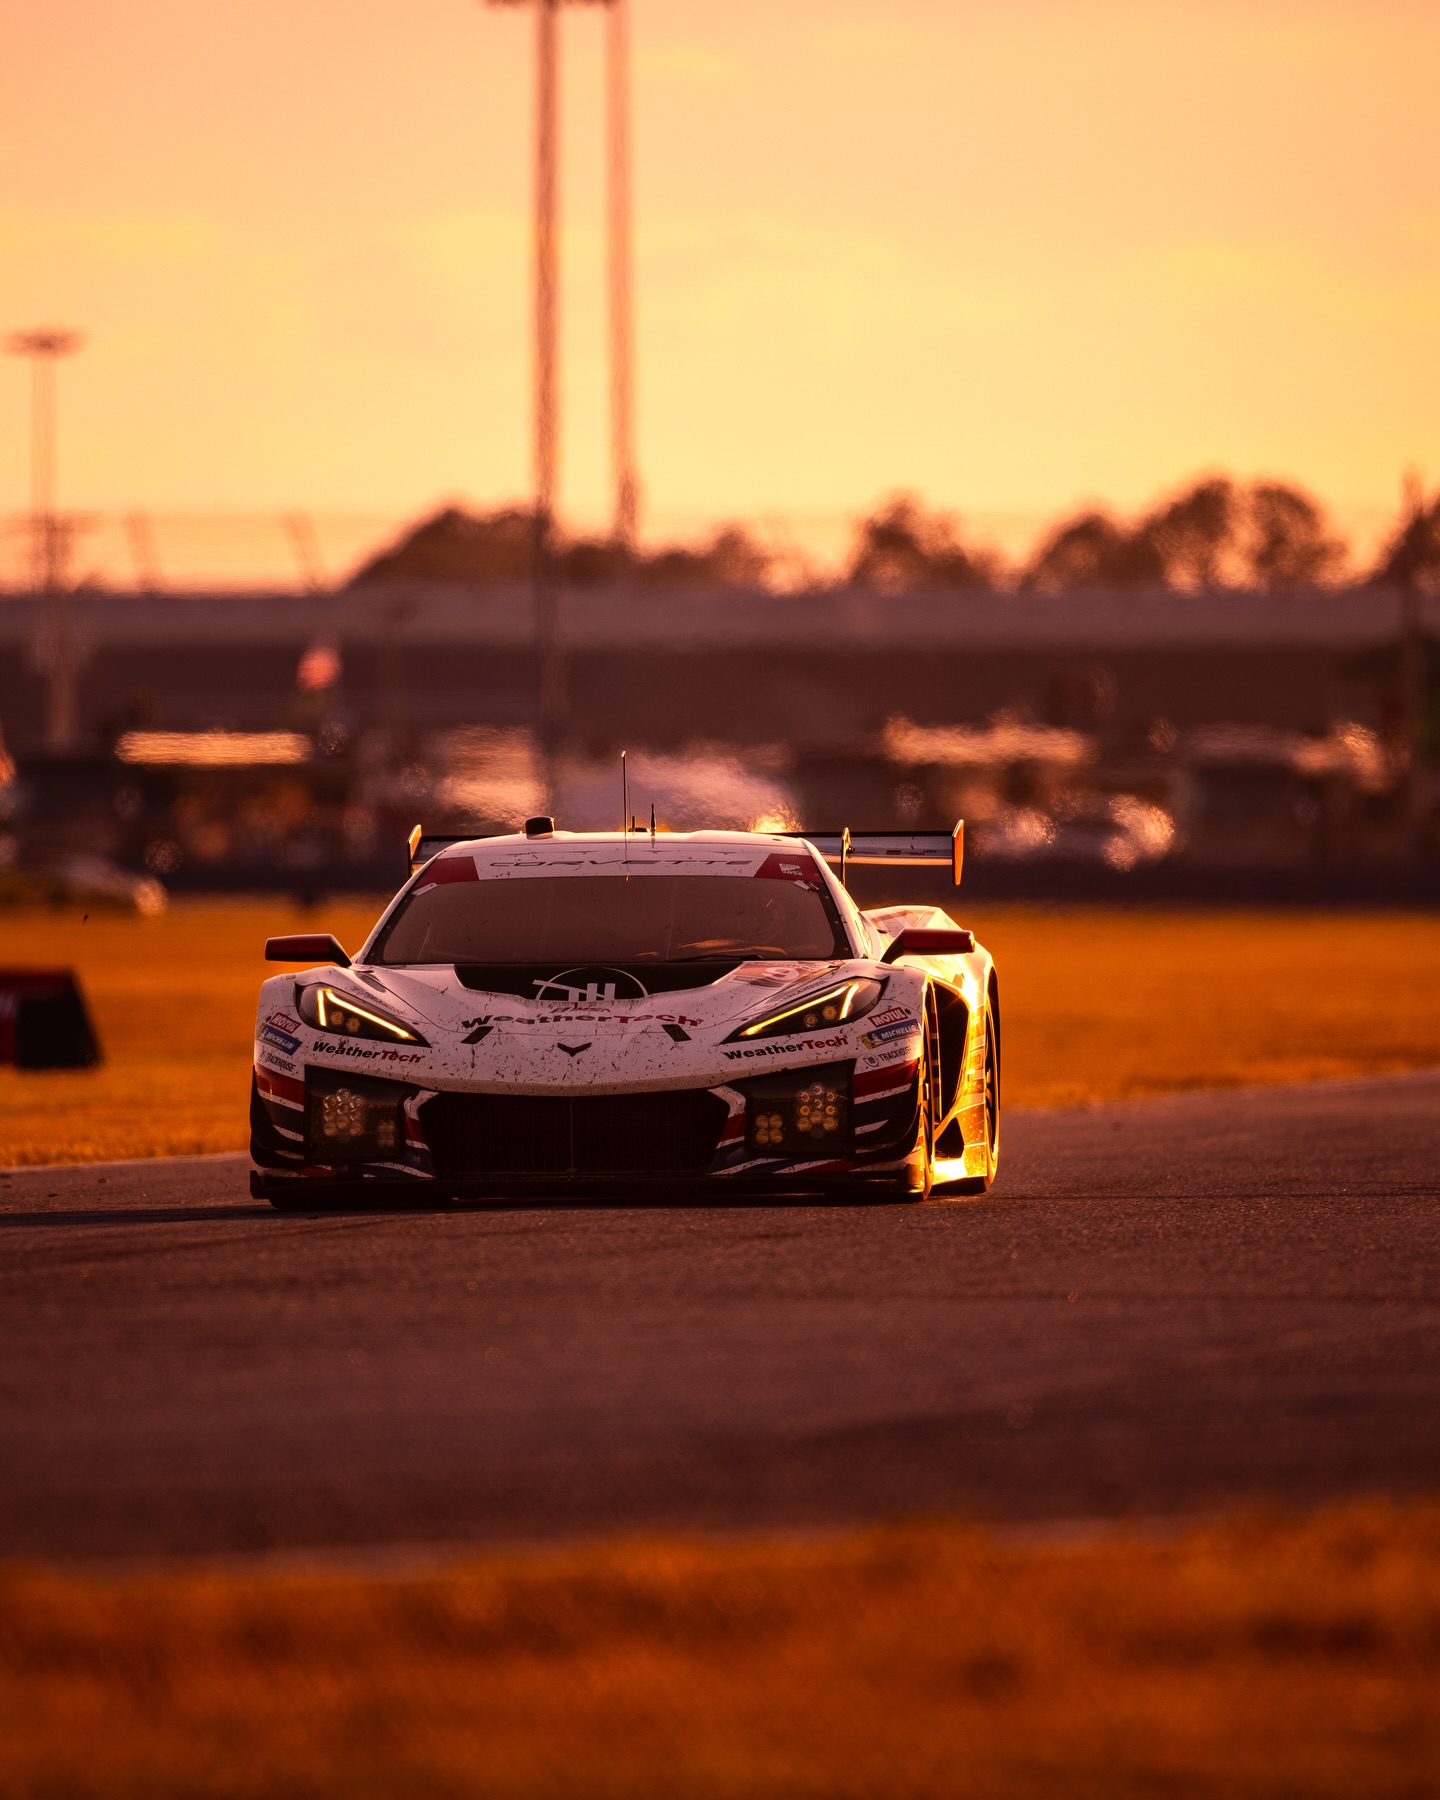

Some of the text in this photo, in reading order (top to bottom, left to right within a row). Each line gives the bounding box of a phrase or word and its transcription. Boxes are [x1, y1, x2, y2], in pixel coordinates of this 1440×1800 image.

[271, 1013, 297, 1032] MOTUL
[460, 1013, 699, 1029] WeatherTech
[871, 1009, 907, 1026] MOTUL
[311, 1040, 423, 1064] WeatherTech
[723, 1035, 849, 1060] WeatherTech
[264, 1051, 297, 1073] TRACKHOUSE
